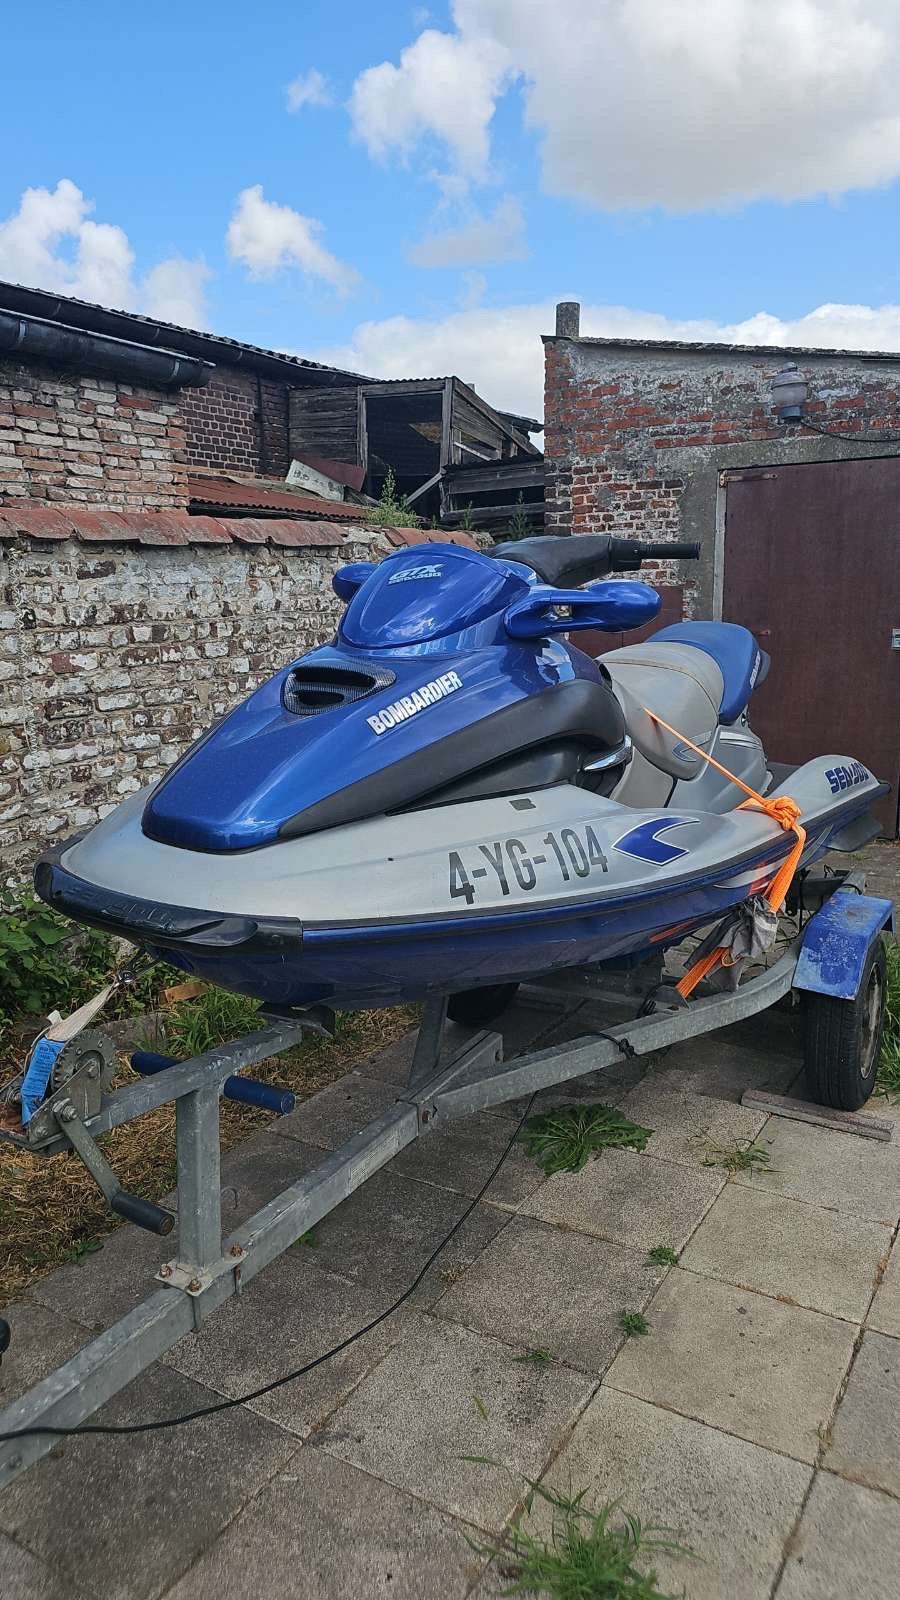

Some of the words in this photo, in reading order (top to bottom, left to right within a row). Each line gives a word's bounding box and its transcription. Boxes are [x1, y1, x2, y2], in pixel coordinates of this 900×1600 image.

[389, 564, 446, 580] GTX
[366, 670, 463, 735] BOMBARDIER
[449, 826, 608, 905] 4-YG-104
